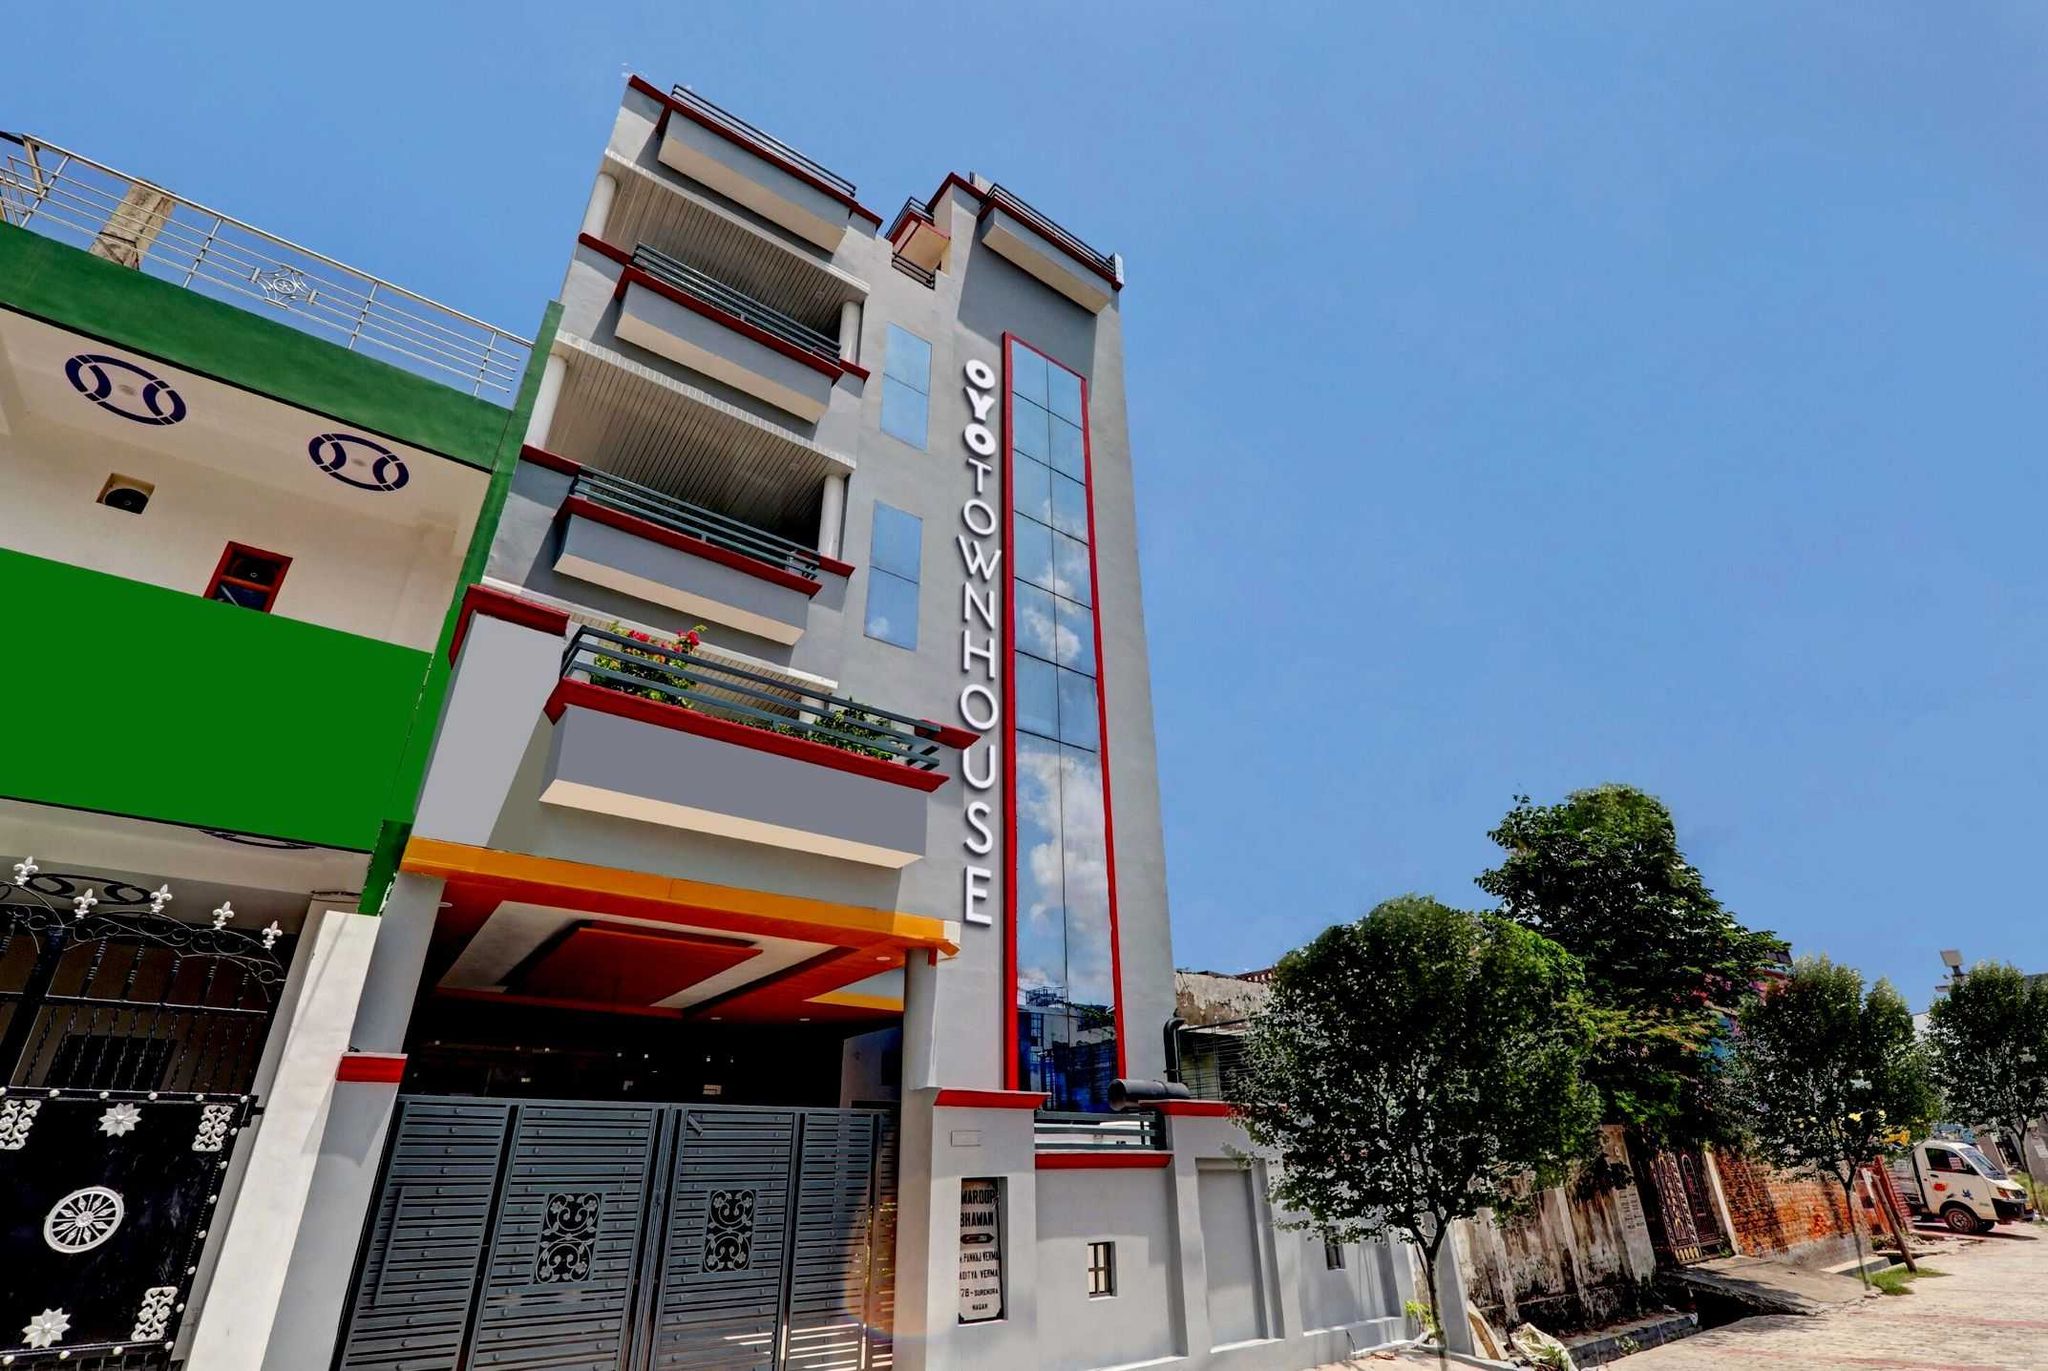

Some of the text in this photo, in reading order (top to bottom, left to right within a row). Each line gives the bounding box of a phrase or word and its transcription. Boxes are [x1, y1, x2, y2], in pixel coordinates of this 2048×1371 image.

[957, 359, 1002, 926] OYO TOWNHOUSE
[980, 1269, 998, 1279] VERMA
